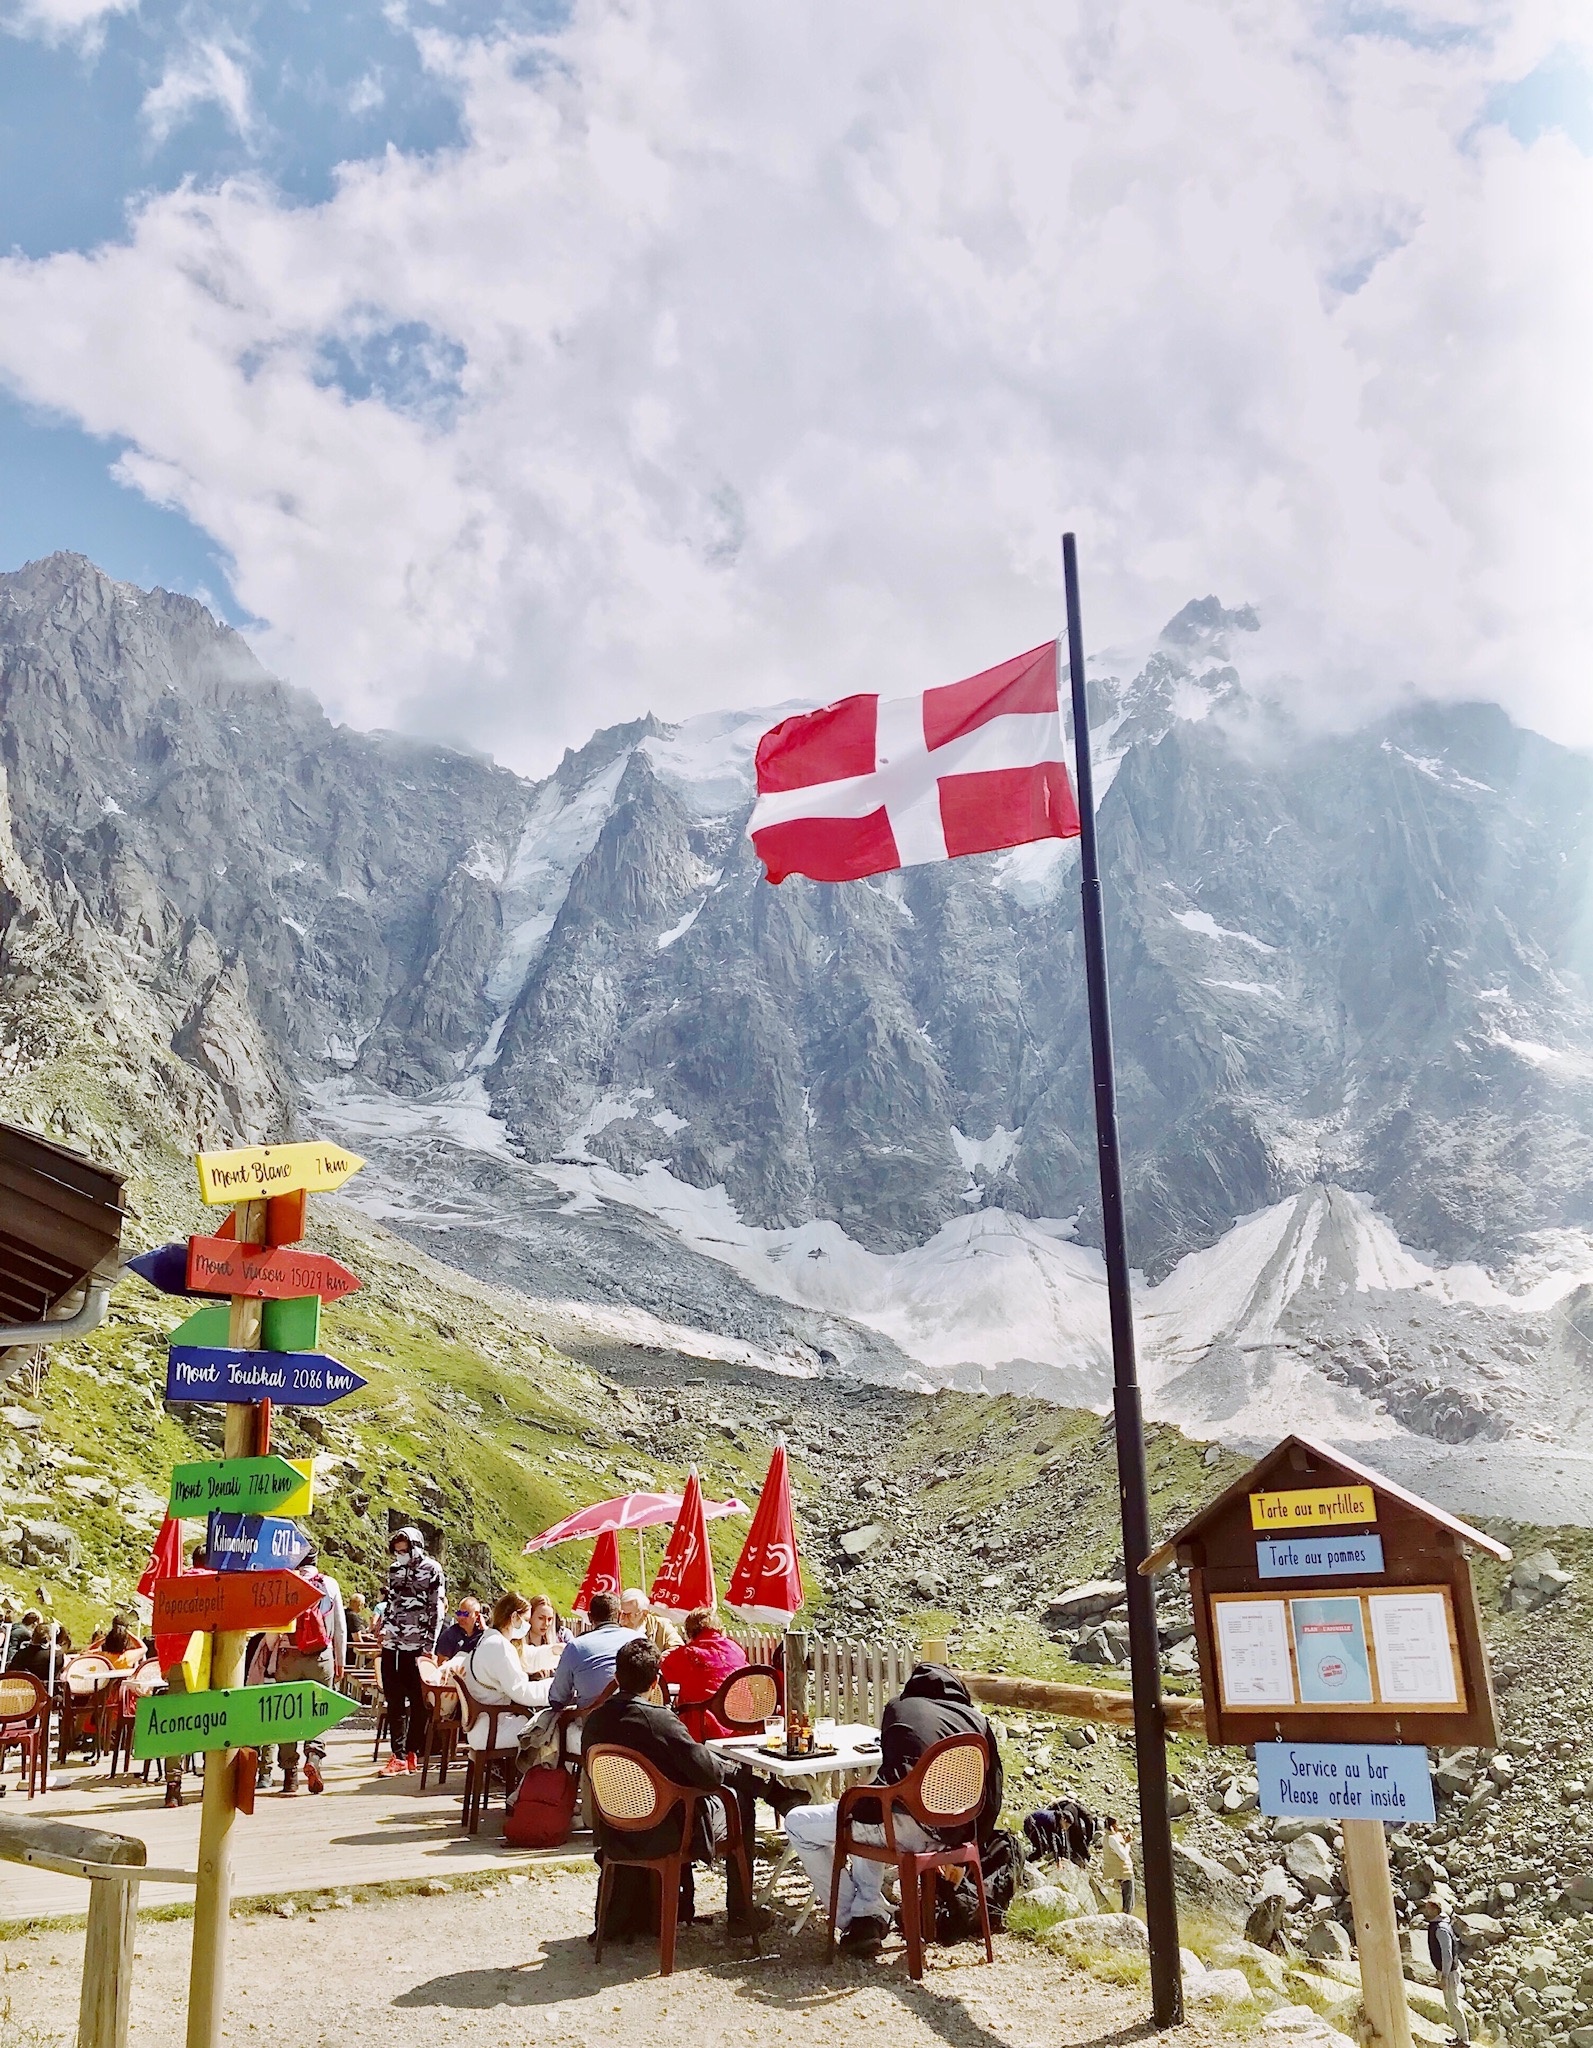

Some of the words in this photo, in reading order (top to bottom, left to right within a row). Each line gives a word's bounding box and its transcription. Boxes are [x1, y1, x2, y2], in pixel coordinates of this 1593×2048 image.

[211, 1165, 250, 1188] Mont
[252, 1162, 292, 1183] Blanc
[315, 1158, 321, 1175] 7
[324, 1157, 348, 1174] km
[196, 1253, 234, 1277] Mont
[242, 1260, 286, 1282] Vinson
[291, 1267, 322, 1290] 15029
[326, 1273, 349, 1291] km
[176, 1362, 220, 1385] Mont
[227, 1363, 286, 1388] Toubkal
[293, 1368, 323, 1389] 2086
[326, 1370, 354, 1390] km
[175, 1480, 203, 1502] Mont
[208, 1476, 241, 1499] Denali
[249, 1474, 270, 1495] 7742
[272, 1473, 292, 1494] km
[1257, 1498, 1288, 1519] Tarte
[1294, 1504, 1312, 1516] aux
[1319, 1493, 1365, 1520] myrtilles
[272, 1529, 290, 1556] 6217
[1269, 1545, 1299, 1566] Tarte
[1305, 1552, 1322, 1564] aux
[1327, 1549, 1366, 1568] pommes
[252, 1580, 283, 1607] 9637
[285, 1581, 299, 1606] km
[148, 1708, 227, 1735] Aconcagua
[258, 1693, 303, 1723] 11701
[312, 1691, 329, 1717] km
[1289, 1751, 1337, 1777] Service
[1345, 1763, 1360, 1777] au
[1367, 1754, 1389, 1779] bar
[1280, 1779, 1318, 1805] Please
[1329, 1781, 1362, 1806] order
[1370, 1782, 1406, 1807] inside
